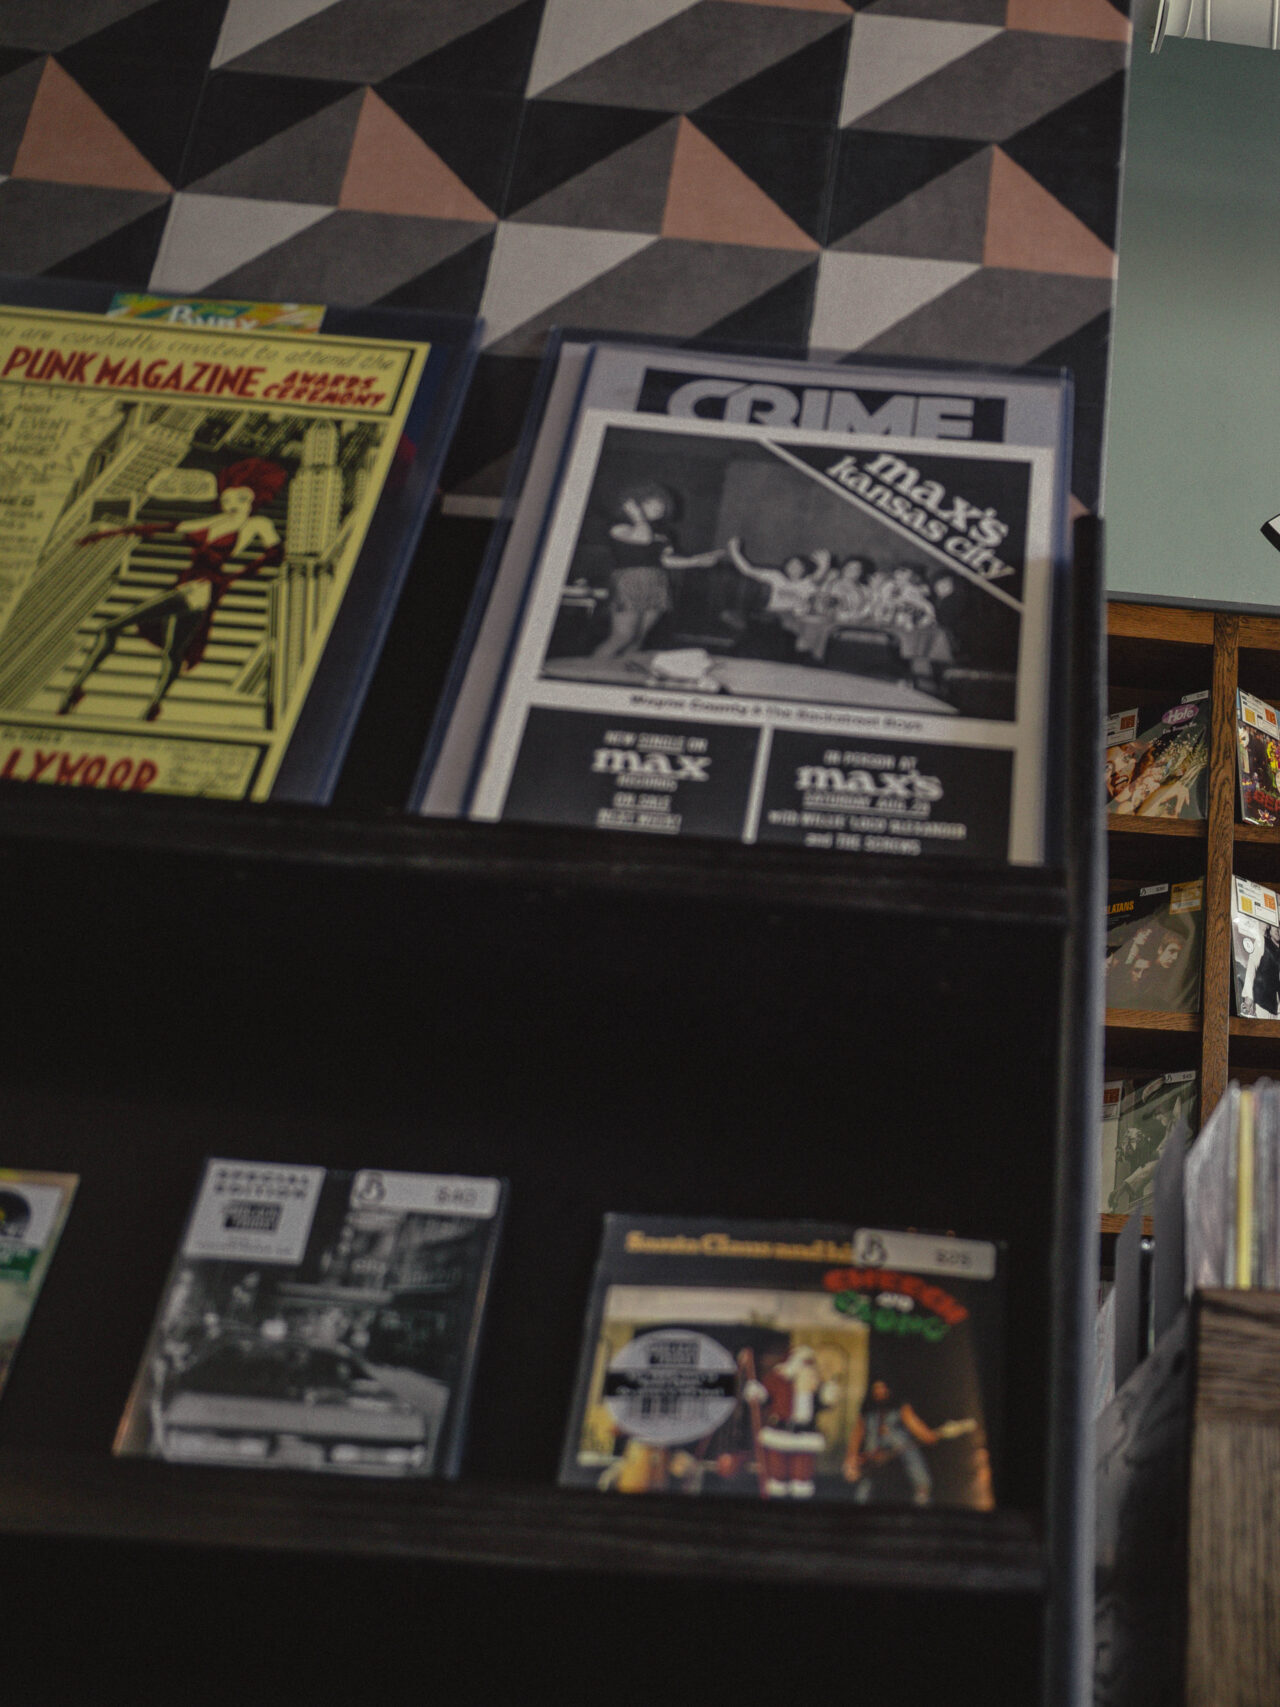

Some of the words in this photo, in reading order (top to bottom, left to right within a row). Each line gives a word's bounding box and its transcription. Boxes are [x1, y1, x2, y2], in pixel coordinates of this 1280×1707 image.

[2, 345, 98, 384] PUNK
[94, 353, 267, 398] MAGAZINE
[283, 370, 379, 392] AWARDS
[262, 383, 387, 408] CEREMONY
[665, 378, 976, 439] CRIME
[825, 455, 950, 543] kansas
[944, 535, 1016, 580] city
[863, 453, 1010, 548] max's
[1167, 705, 1195, 724] Hole
[2, 748, 158, 792] LYWOOD
[591, 748, 712, 782] max
[795, 765, 944, 802] max's
[1106, 900, 1135, 915] LATANS
